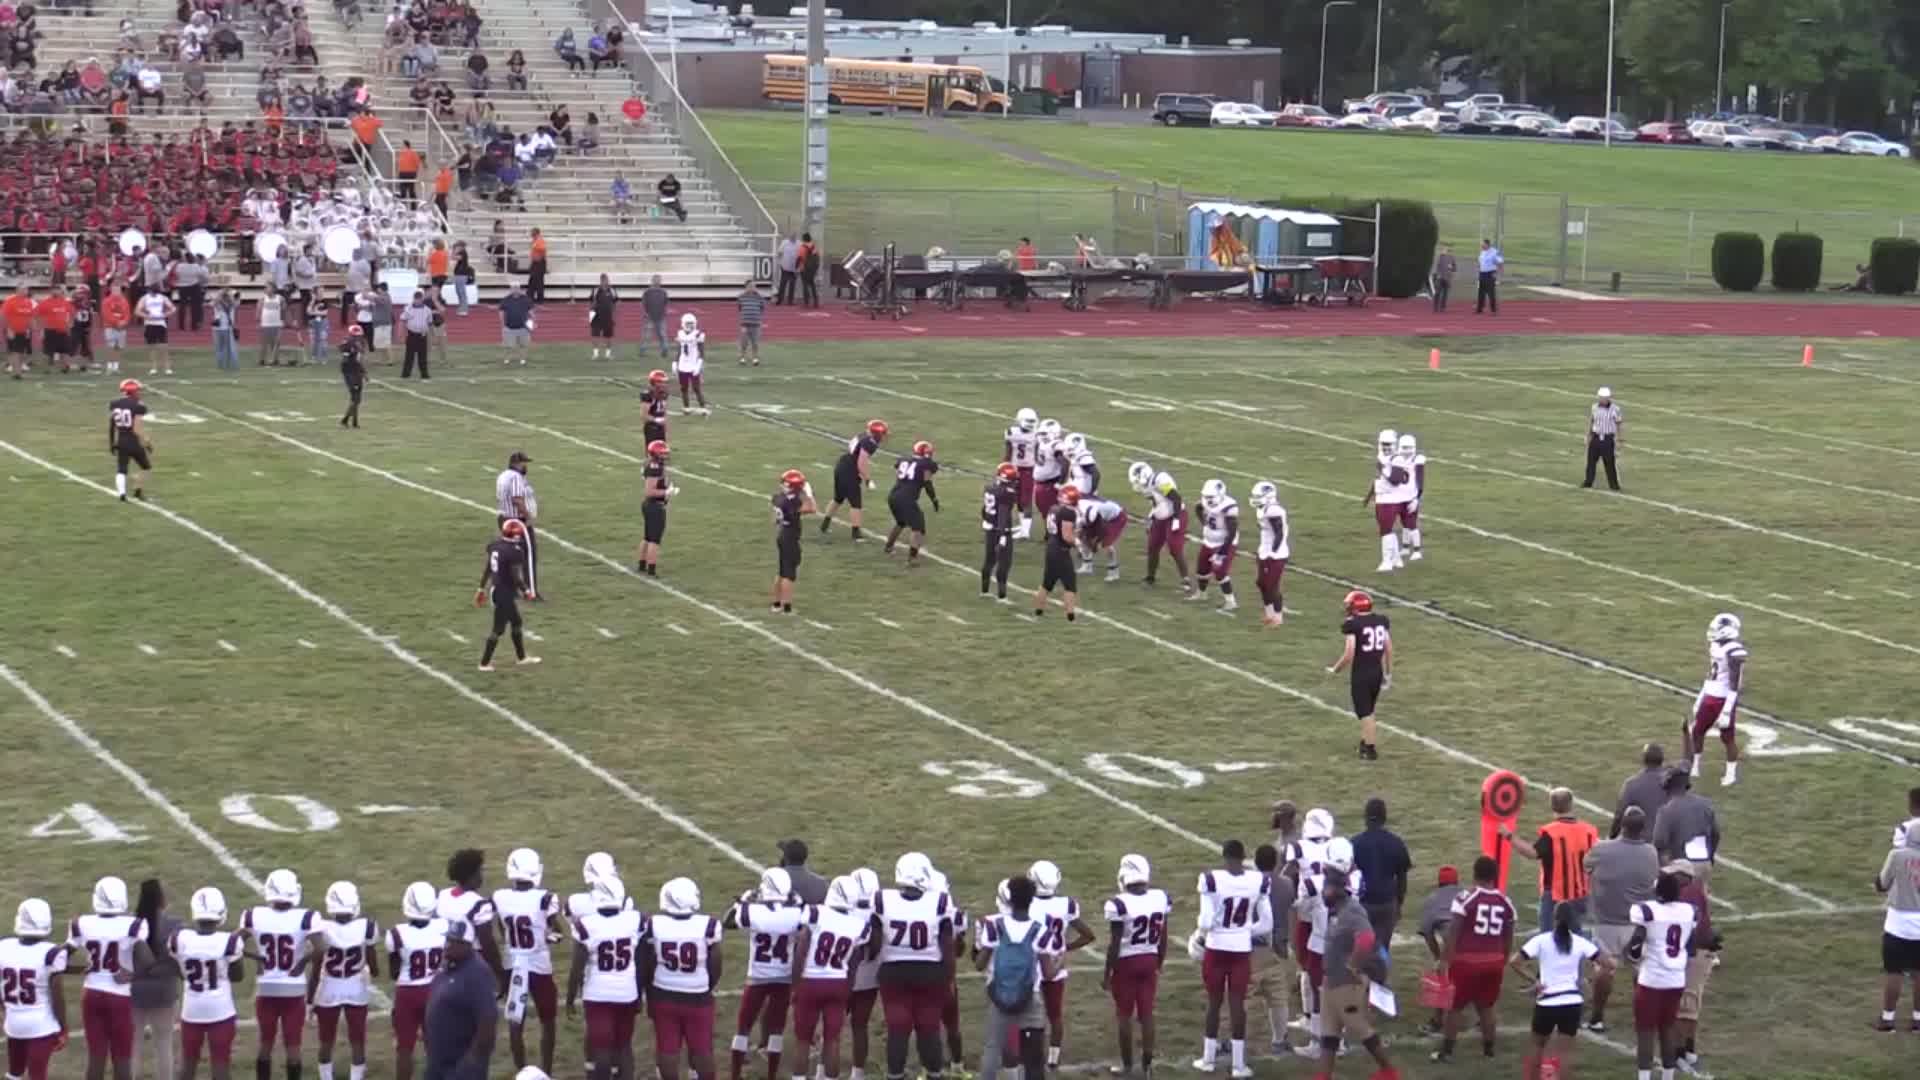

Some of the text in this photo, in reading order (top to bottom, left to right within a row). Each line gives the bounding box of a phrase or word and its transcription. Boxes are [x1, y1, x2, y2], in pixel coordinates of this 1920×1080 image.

[757, 257, 772, 280] 10
[112, 408, 132, 427] 20
[898, 461, 917, 480] 94
[1362, 625, 1385, 652] 38
[1131, 912, 1164, 947] 26
[1223, 896, 1250, 929] 14
[1473, 903, 1505, 936] 55
[505, 914, 535, 949] 16
[755, 931, 790, 965] 24
[889, 920, 929, 951] 70
[1666, 924, 1684, 958] 9
[85, 940, 120, 973] 34
[261, 931, 297, 971] 36
[326, 946, 363, 978] 22
[597, 937, 632, 973] 65
[660, 937, 698, 973] 59
[814, 931, 853, 970] 88
[1, 969, 36, 1005] 25
[185, 959, 219, 993] 21
